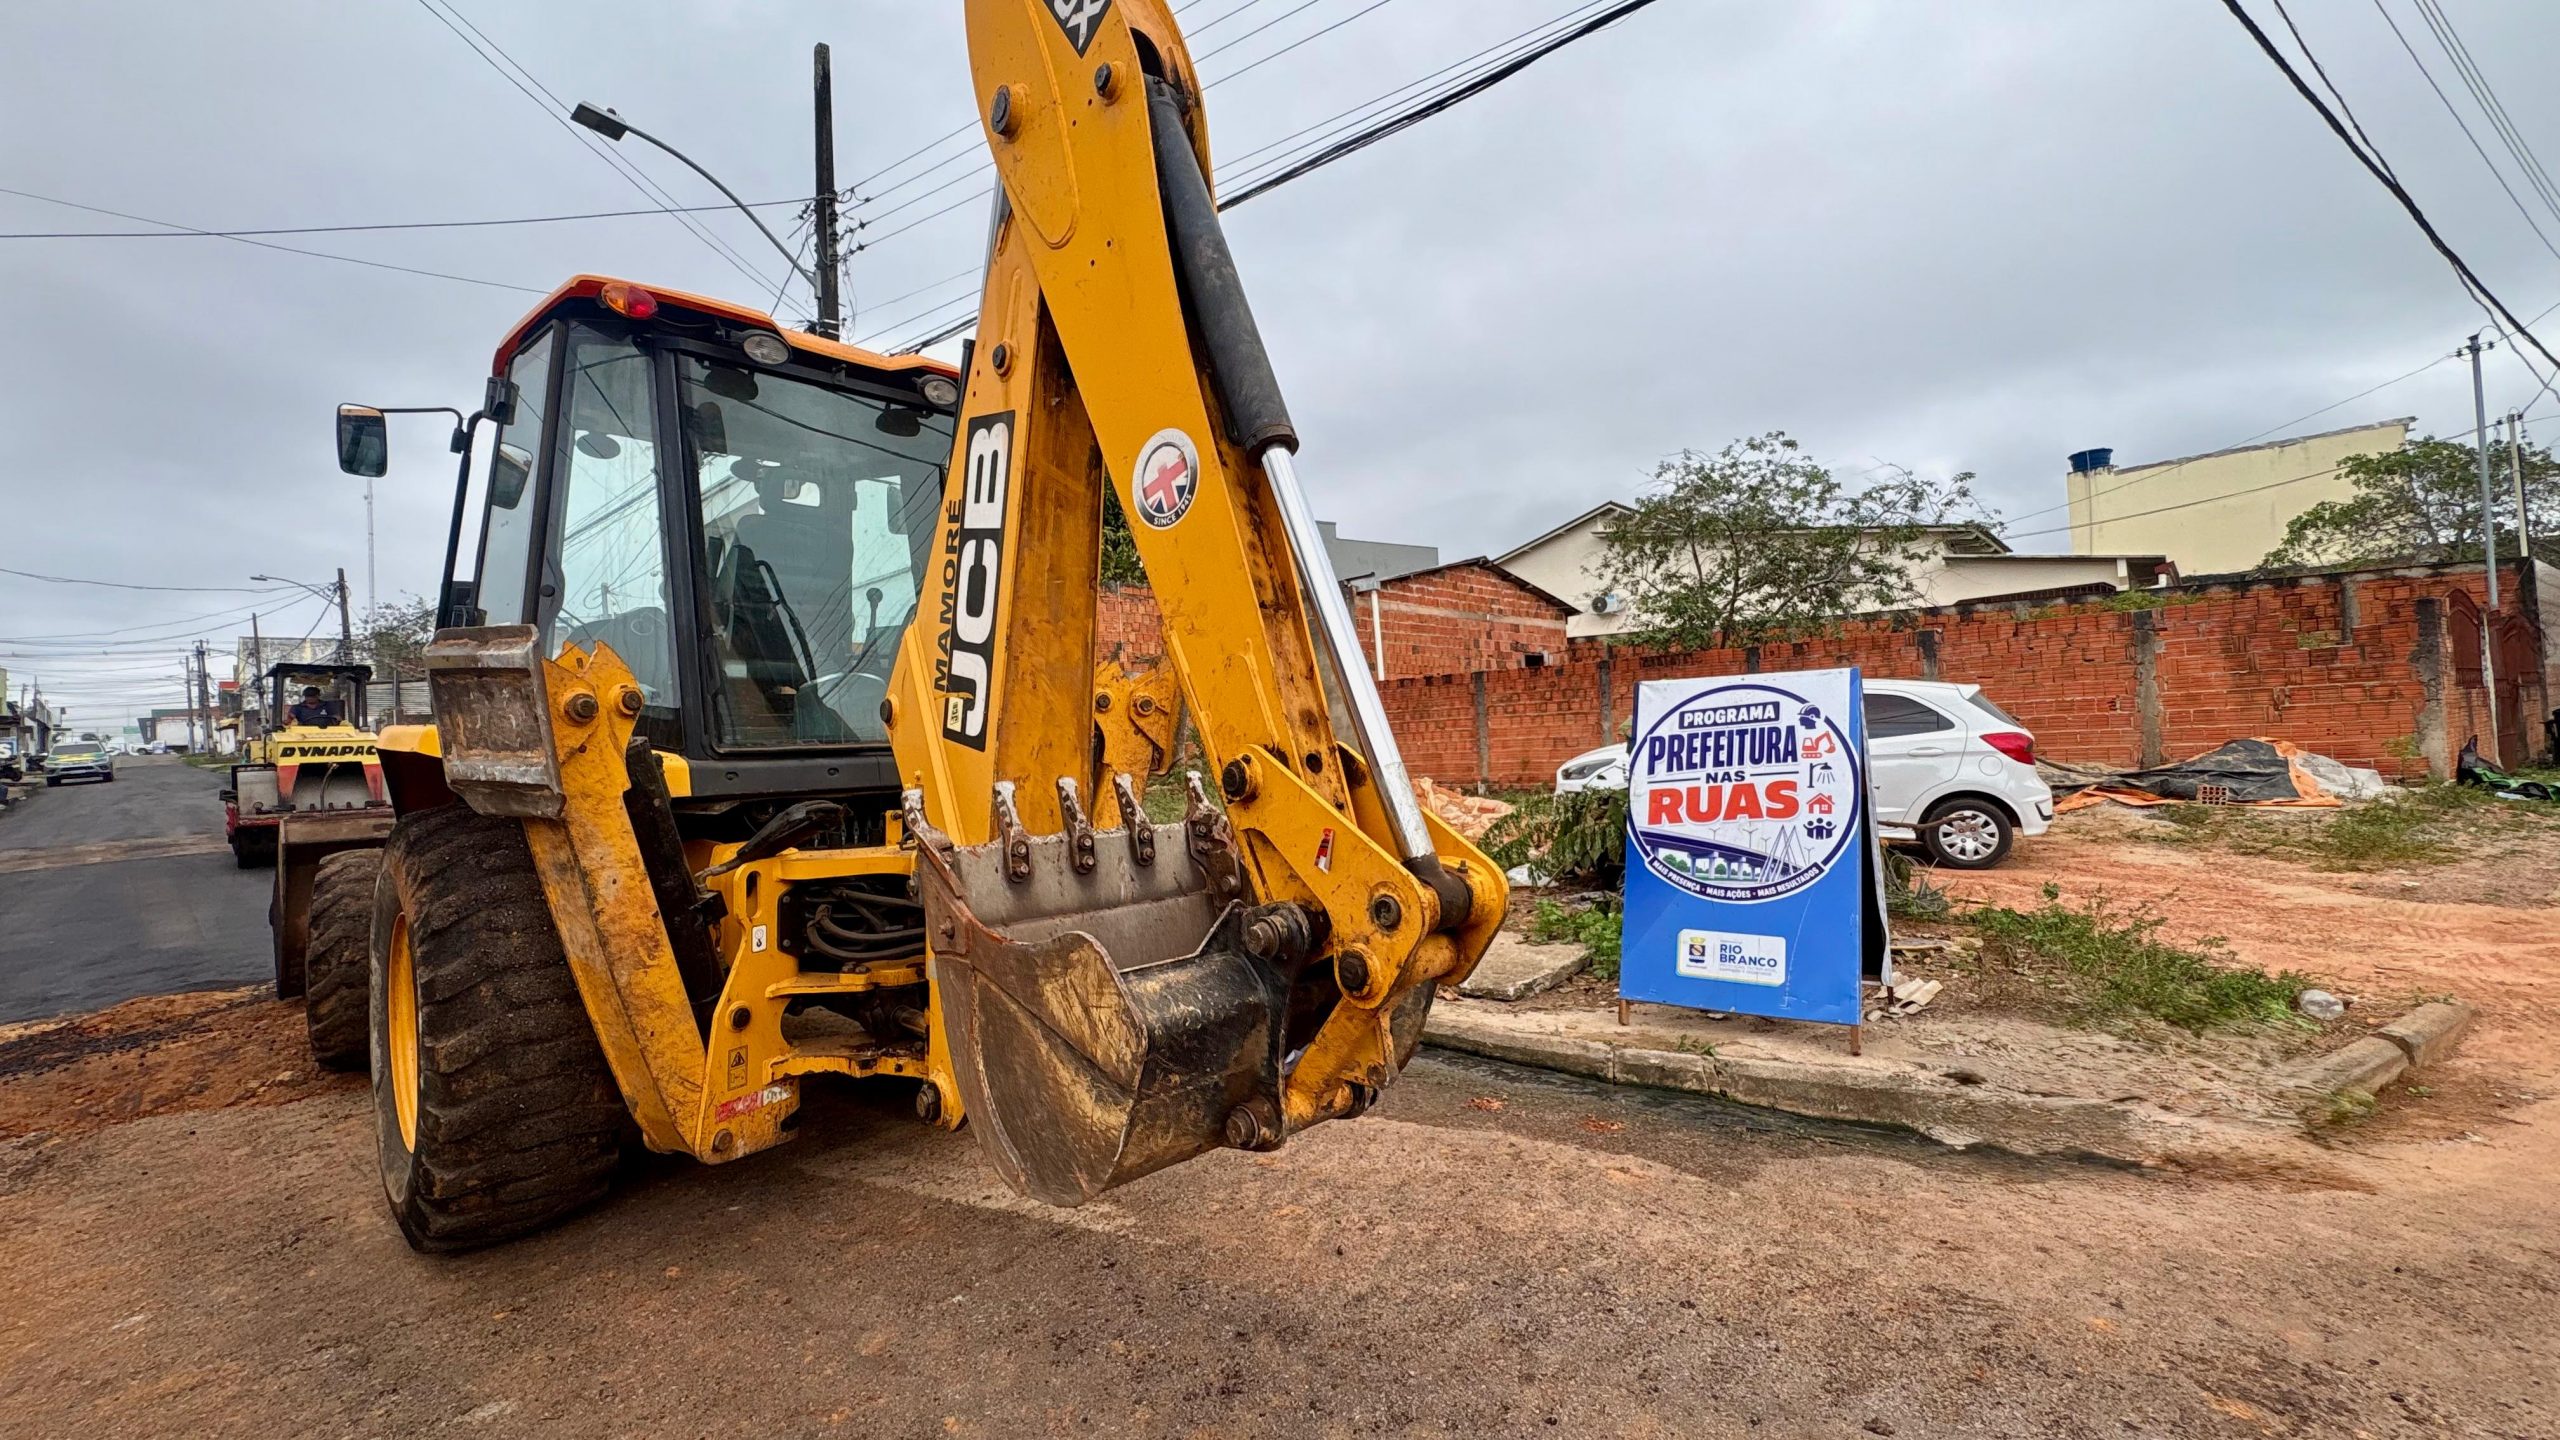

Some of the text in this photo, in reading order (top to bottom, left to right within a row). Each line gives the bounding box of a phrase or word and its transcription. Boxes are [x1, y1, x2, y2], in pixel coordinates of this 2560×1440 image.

[1153, 494, 1192, 526] SINCE 1945
[934, 499, 961, 692] MAMORÉ
[950, 422, 1009, 737] JCB
[1683, 704, 1776, 727] PROGRAMA
[1647, 725, 1798, 776] PREFEITURA
[1705, 770, 1746, 784] NAS
[1648, 780, 1800, 826] RUAS
[1651, 859, 1819, 899] MAIS PRESENÇA MAIS AÇÕES MAIS RESULTADOS
[1720, 943, 1742, 955] RIO
[1720, 954, 1777, 968] BRANCO
